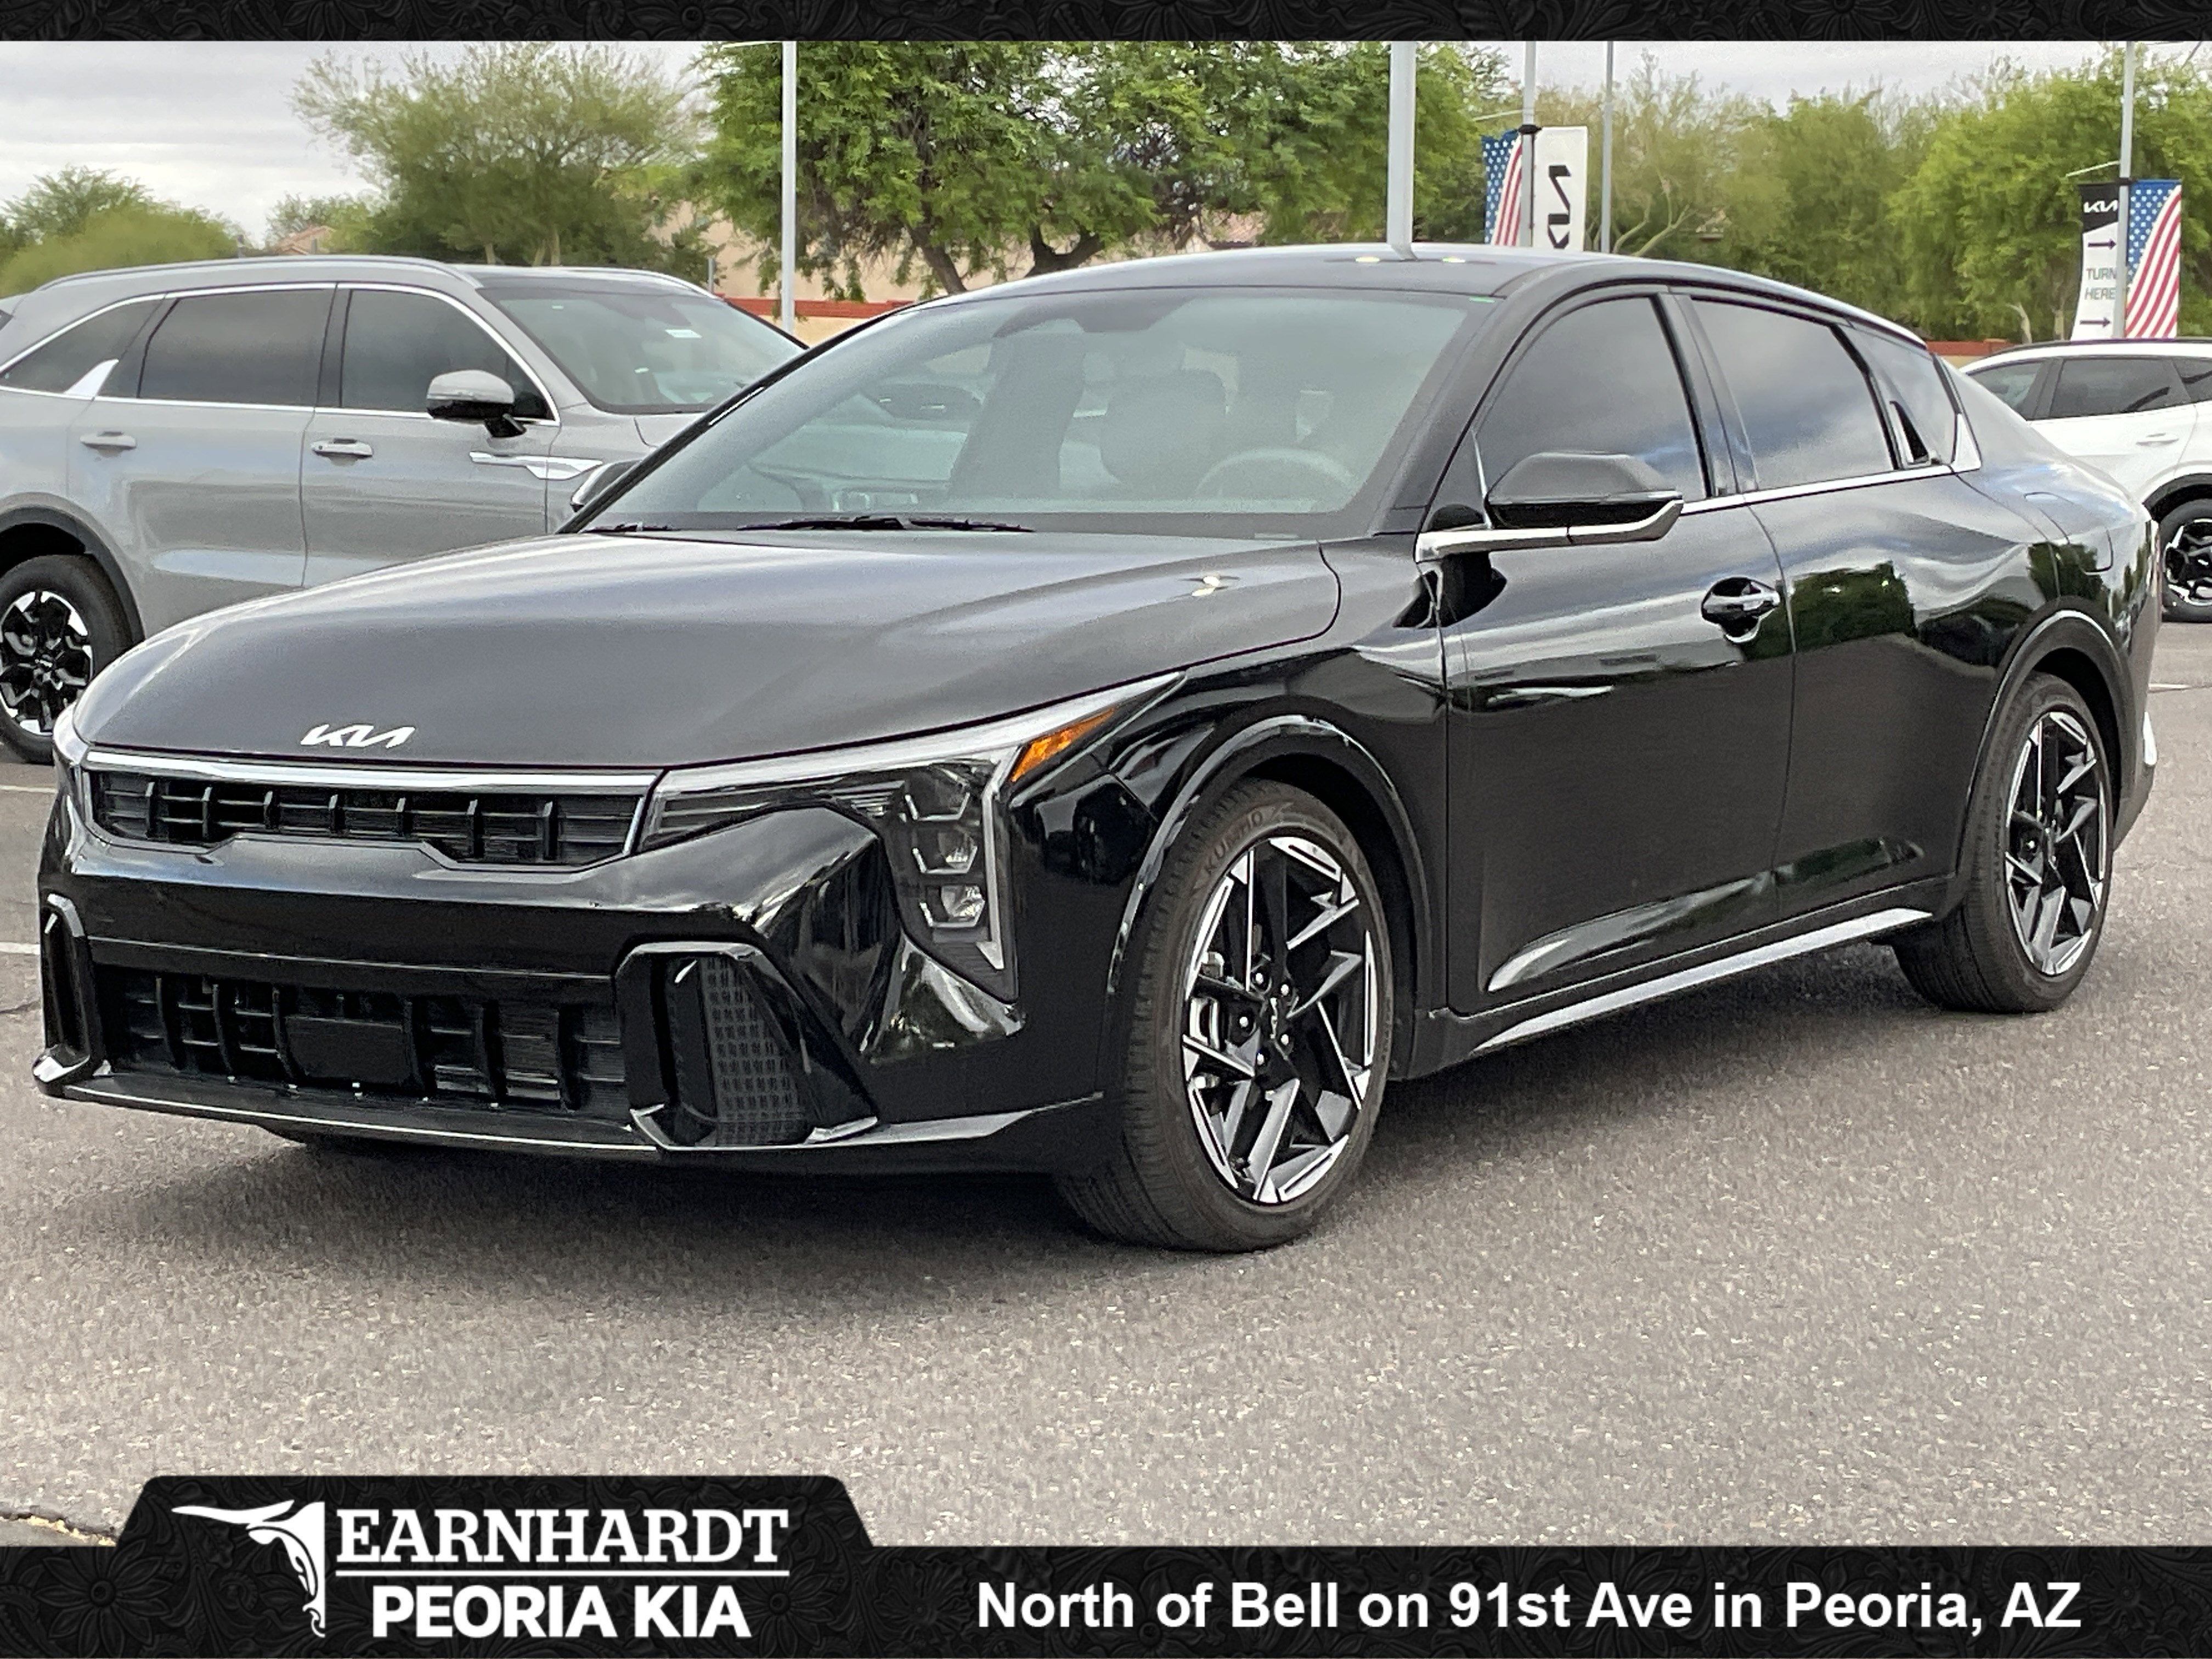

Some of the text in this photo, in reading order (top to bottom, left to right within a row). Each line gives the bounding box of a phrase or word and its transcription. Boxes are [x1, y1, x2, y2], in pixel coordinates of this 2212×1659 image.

[2083, 200, 2119, 213] KIA
[2086, 267, 2117, 280] TURN
[2084, 287, 2117, 300] HERE
[300, 724, 416, 749] KIA
